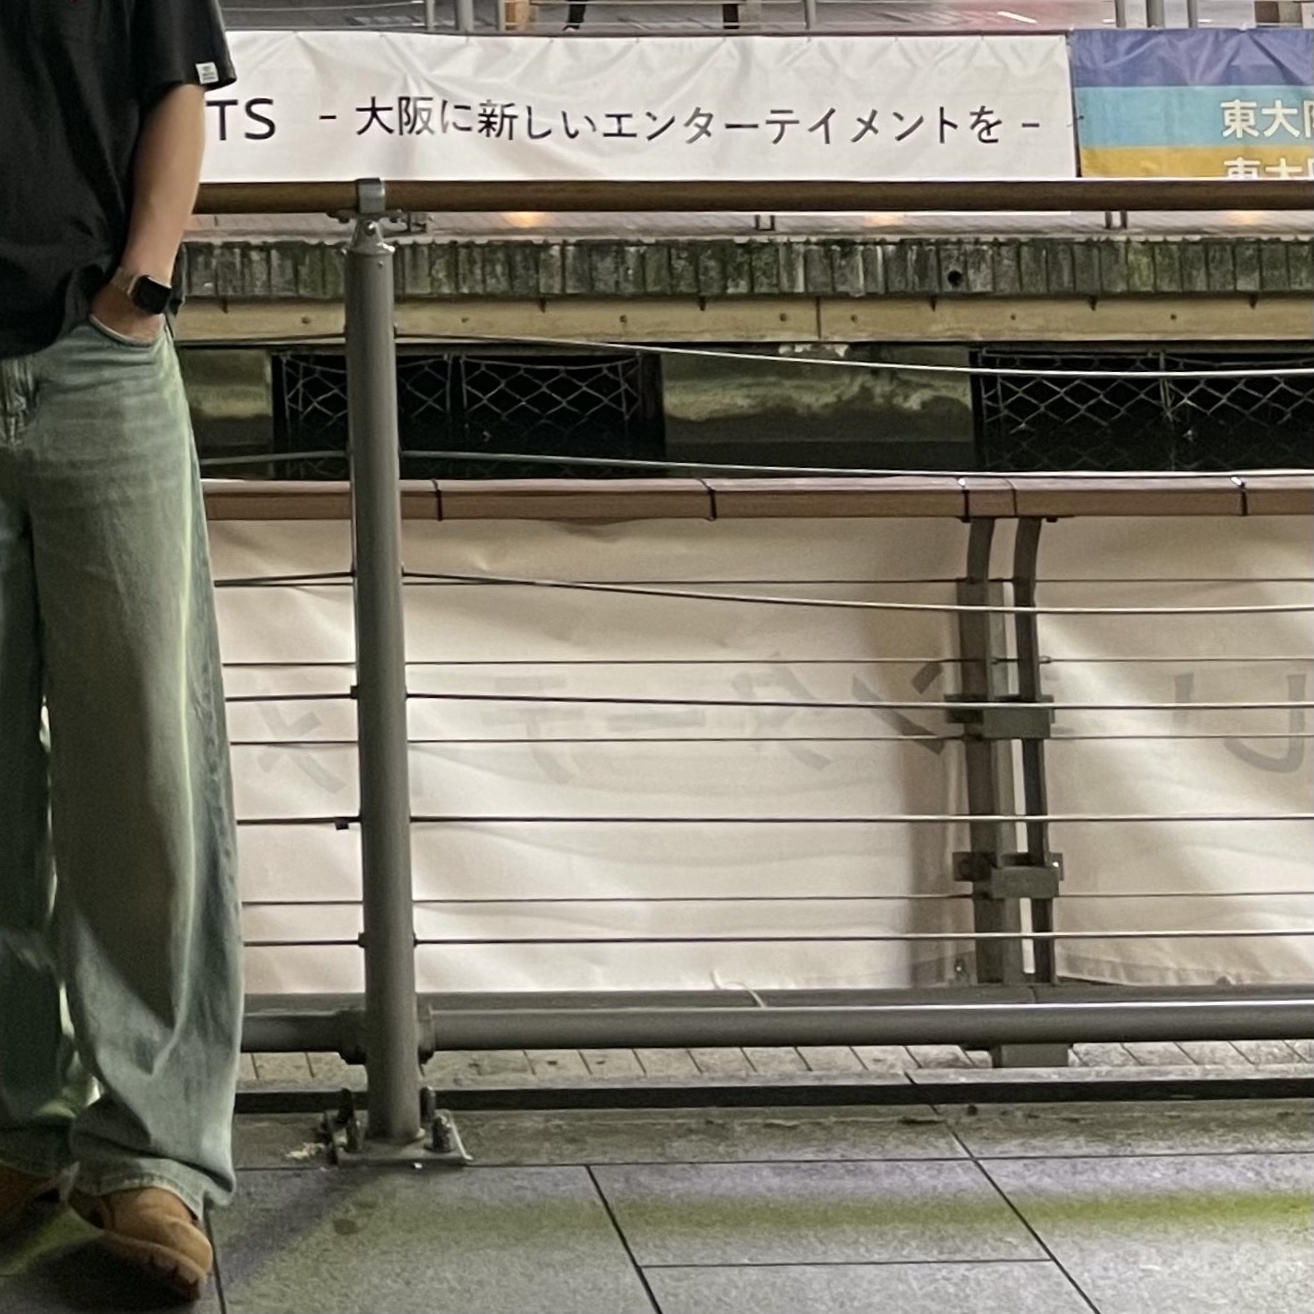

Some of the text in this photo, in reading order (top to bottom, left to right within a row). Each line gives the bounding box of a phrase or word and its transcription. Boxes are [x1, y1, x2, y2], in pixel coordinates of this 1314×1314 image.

[355, 95, 1002, 145] 大阪に新しいエンターテイメントを
[1220, 99, 1314, 138] 東大
